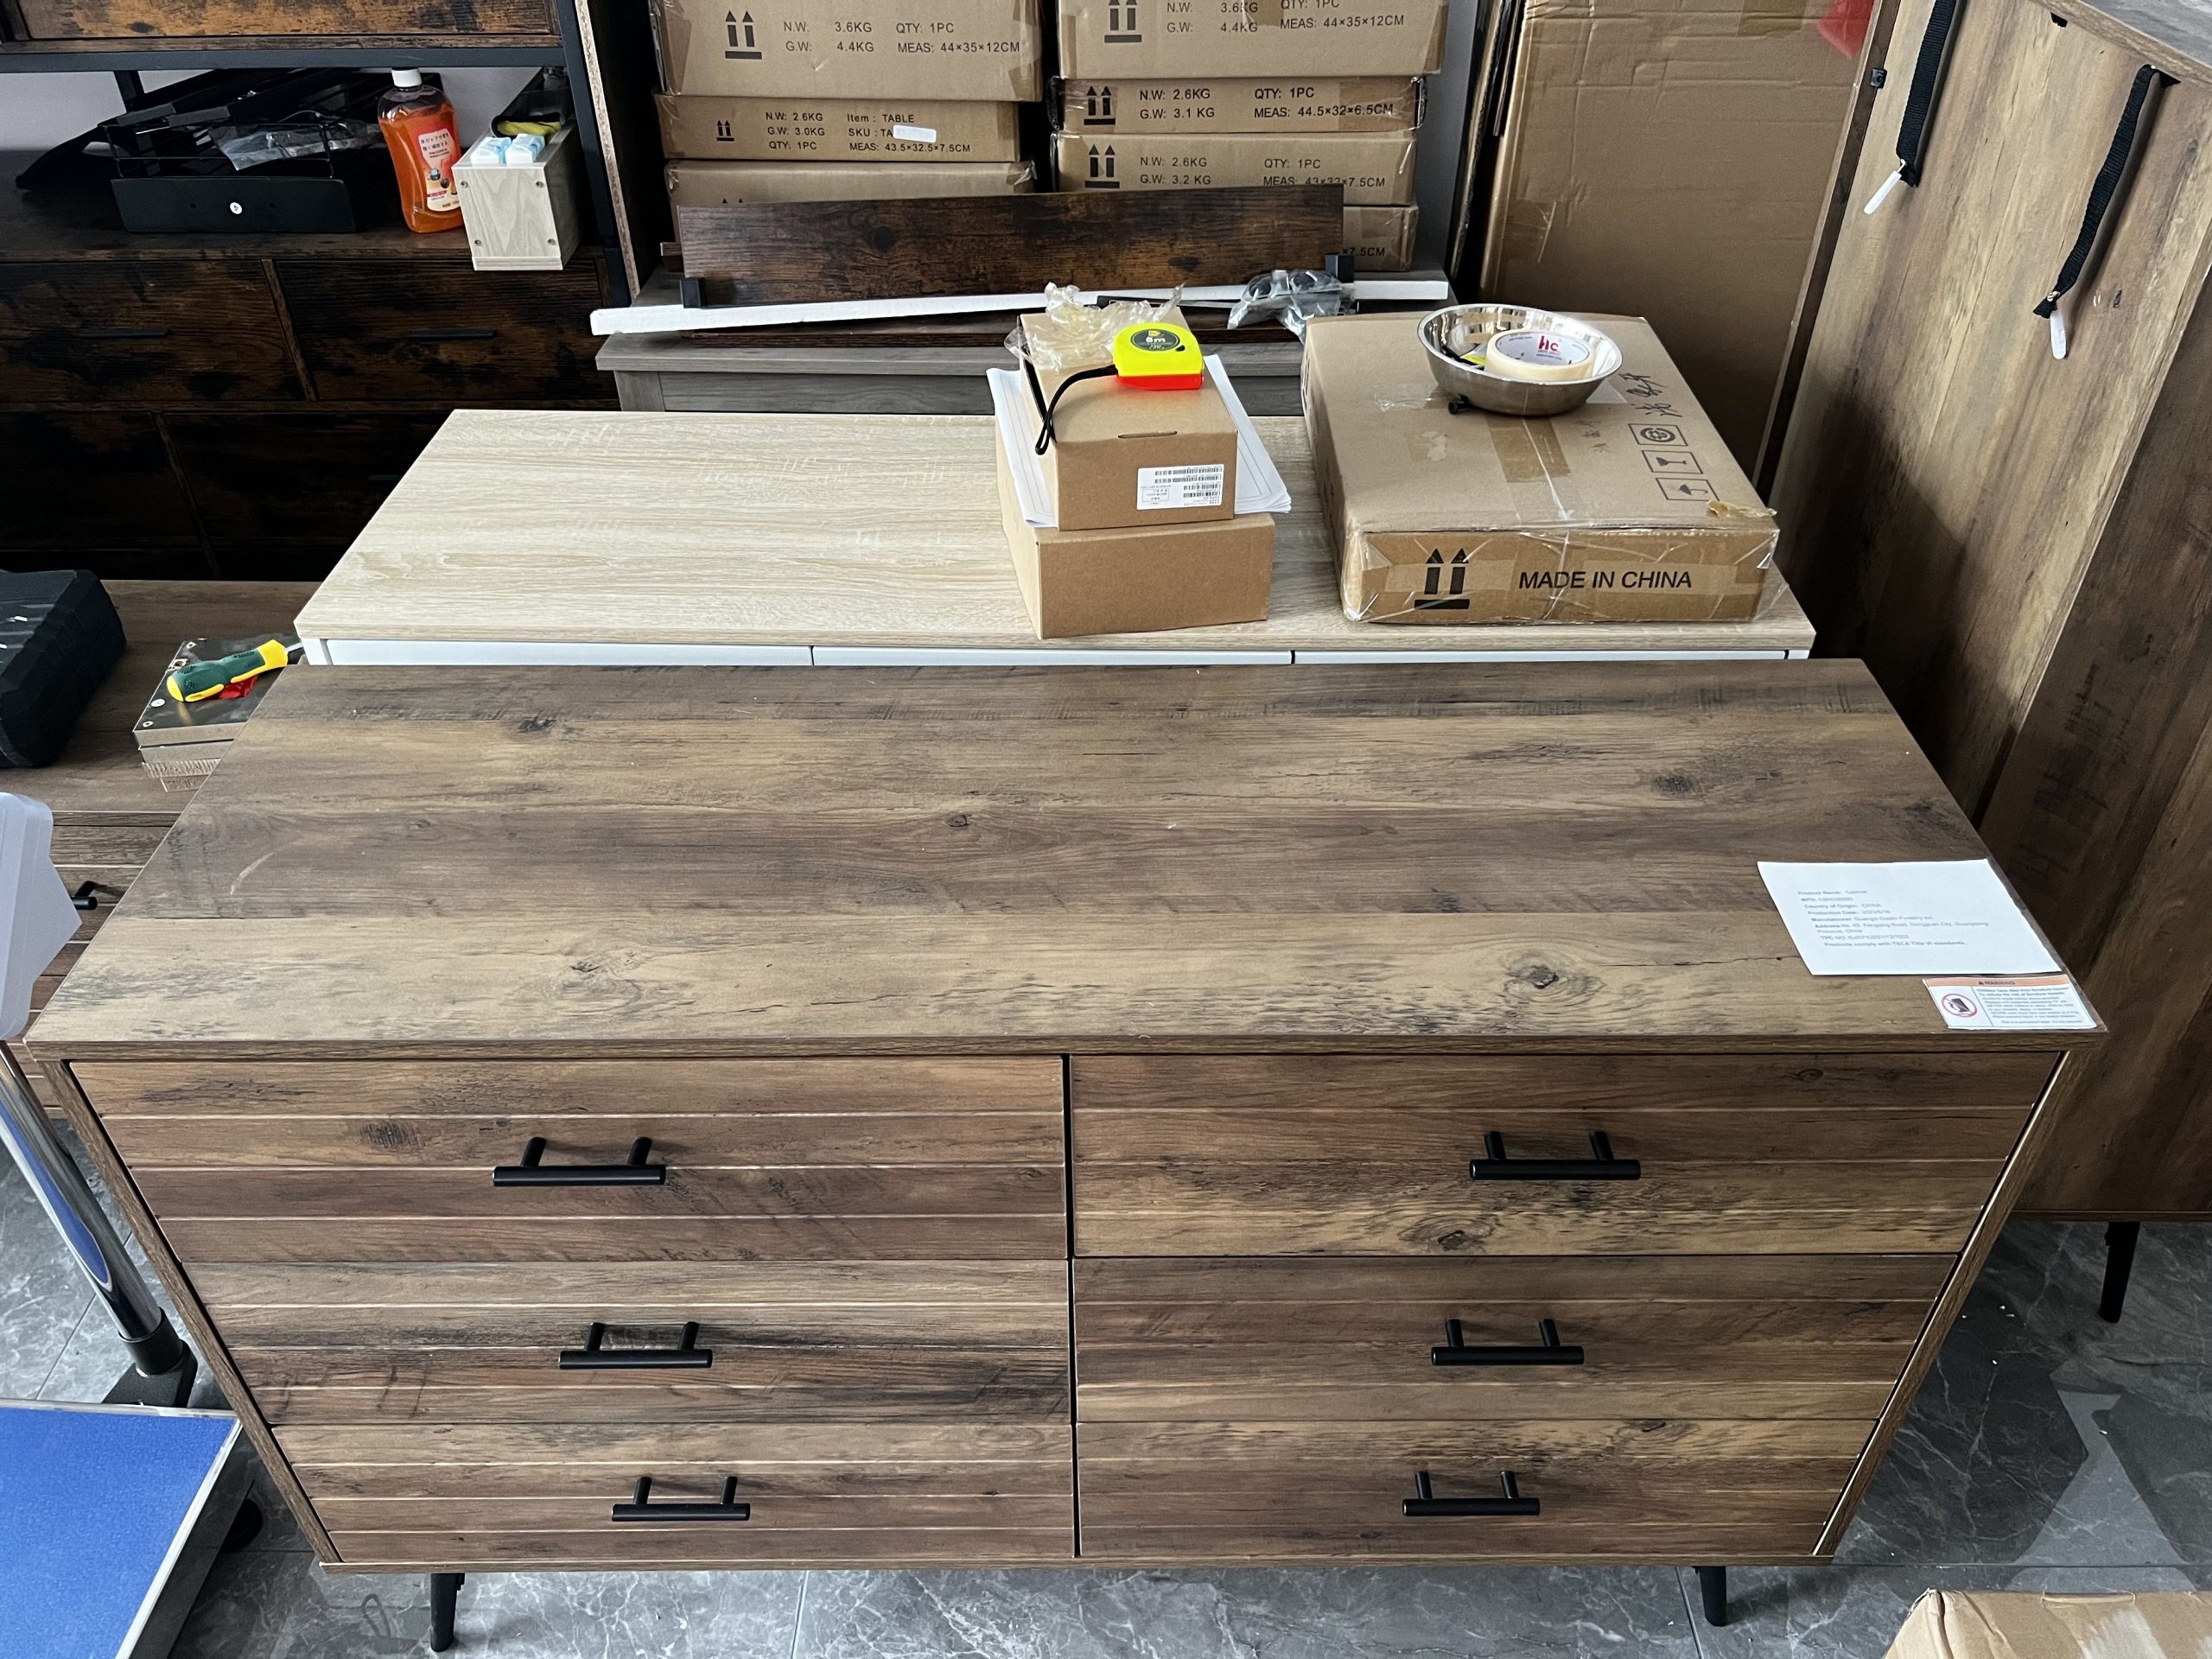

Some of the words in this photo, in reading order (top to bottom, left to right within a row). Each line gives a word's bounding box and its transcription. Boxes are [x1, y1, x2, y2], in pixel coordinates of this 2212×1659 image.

[1220, 2, 1258, 13] 3.6KG
[835, 22, 872, 33] 3.6KG
[895, 22, 924, 34] QTY:
[929, 22, 955, 34] 1PC
[1220, 22, 1258, 33] 4.4KG
[1280, 17, 1318, 29] MEAS:
[836, 41, 874, 53] 4.4KG
[898, 42, 935, 54] MEAS:
[1173, 88, 1211, 100] 2.6KG
[1254, 88, 1282, 99] QTY:
[1289, 86, 1315, 99] 1PC
[1254, 107, 1291, 118] MEAS:
[881, 114, 915, 124] TABLE
[794, 127, 825, 137] 3.0KG
[848, 128, 871, 137] SKU
[768, 141, 791, 150] QTY:
[797, 142, 817, 150] 1PC
[849, 143, 880, 152] MEAS:
[1172, 157, 1207, 168] 2.6KG
[1264, 159, 1291, 169] QTY:
[1298, 159, 1321, 169] 1PC
[1518, 571, 1586, 589] MADE
[1592, 571, 1615, 588] IN
[1621, 571, 1692, 588] CHINA
